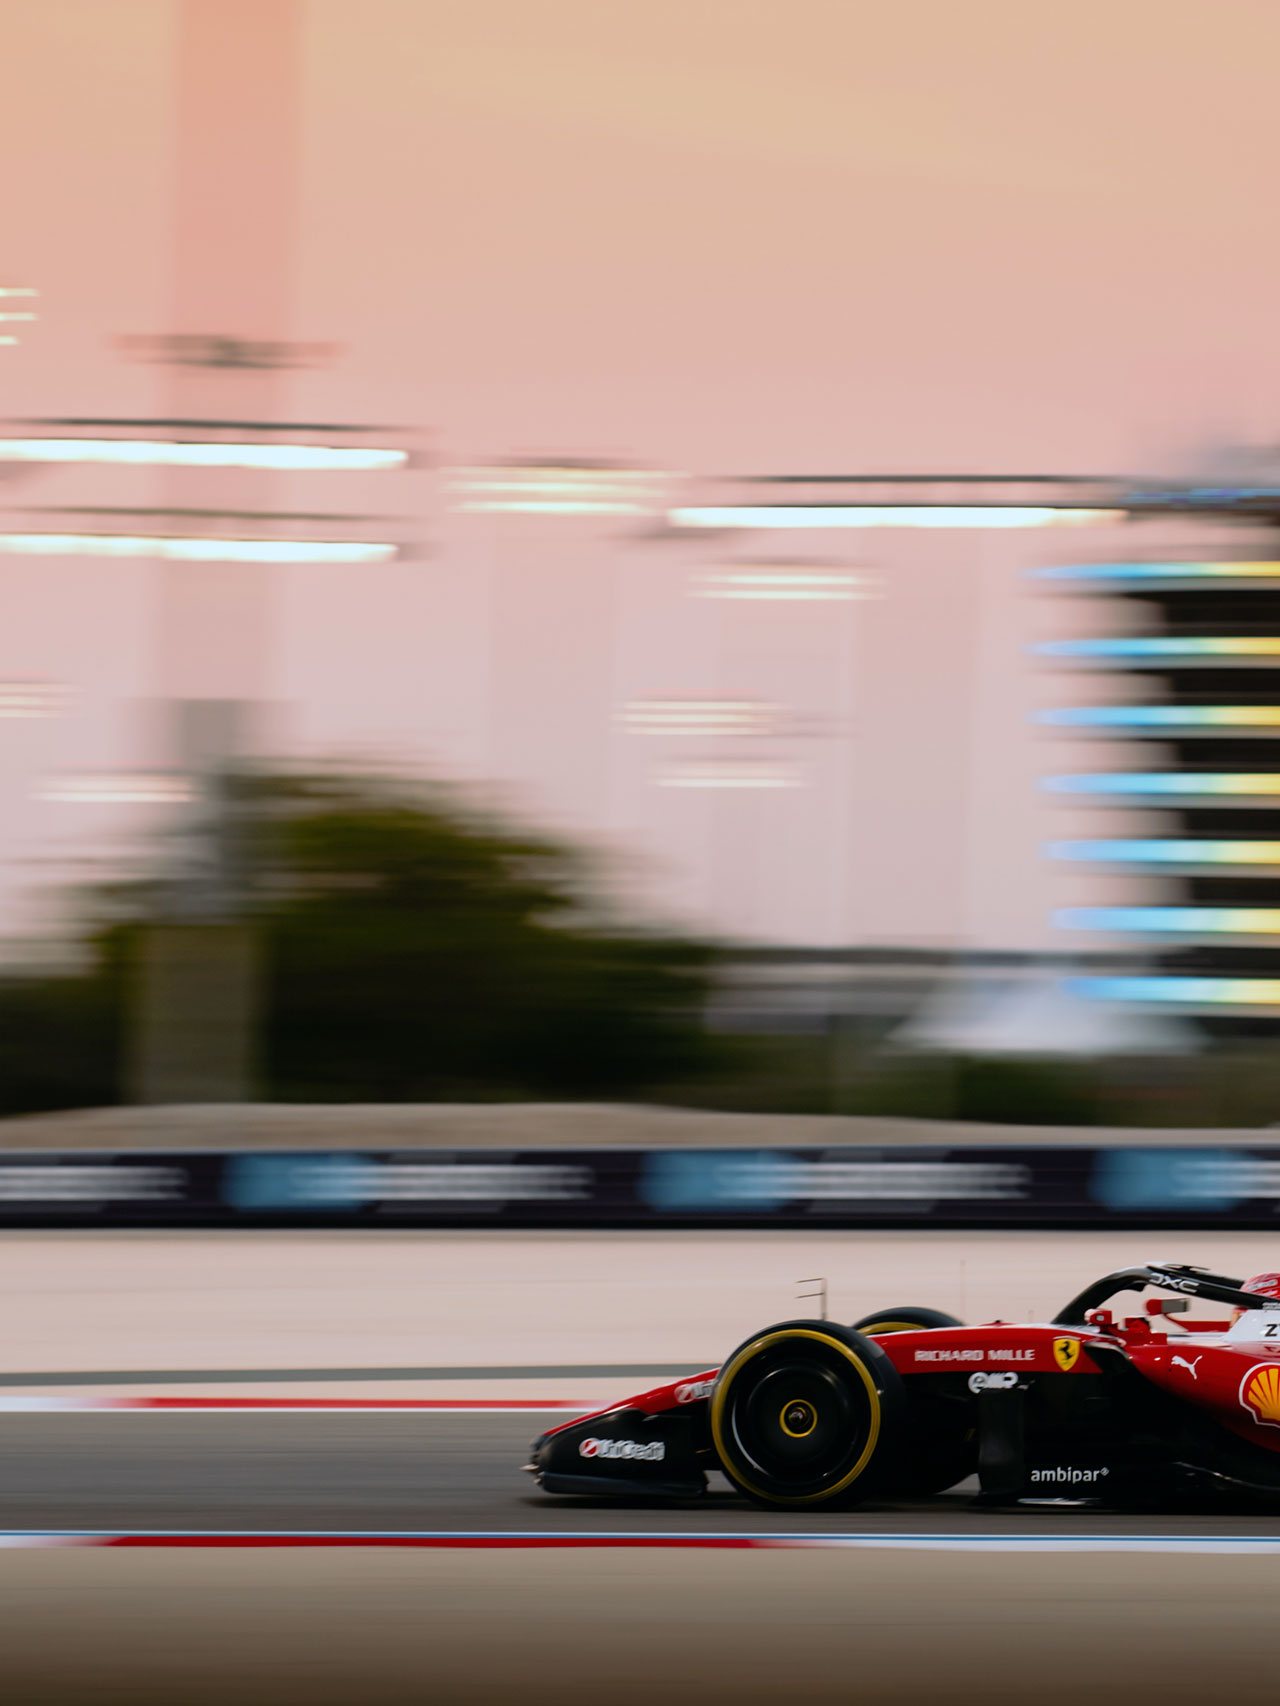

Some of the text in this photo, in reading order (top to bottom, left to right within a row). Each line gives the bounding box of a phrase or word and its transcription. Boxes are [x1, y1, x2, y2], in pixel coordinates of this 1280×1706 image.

[1149, 1272, 1199, 1293] DXC
[914, 1349, 1036, 1361] RICHARD MILLE
[1030, 1466, 1100, 1484] ambipar
